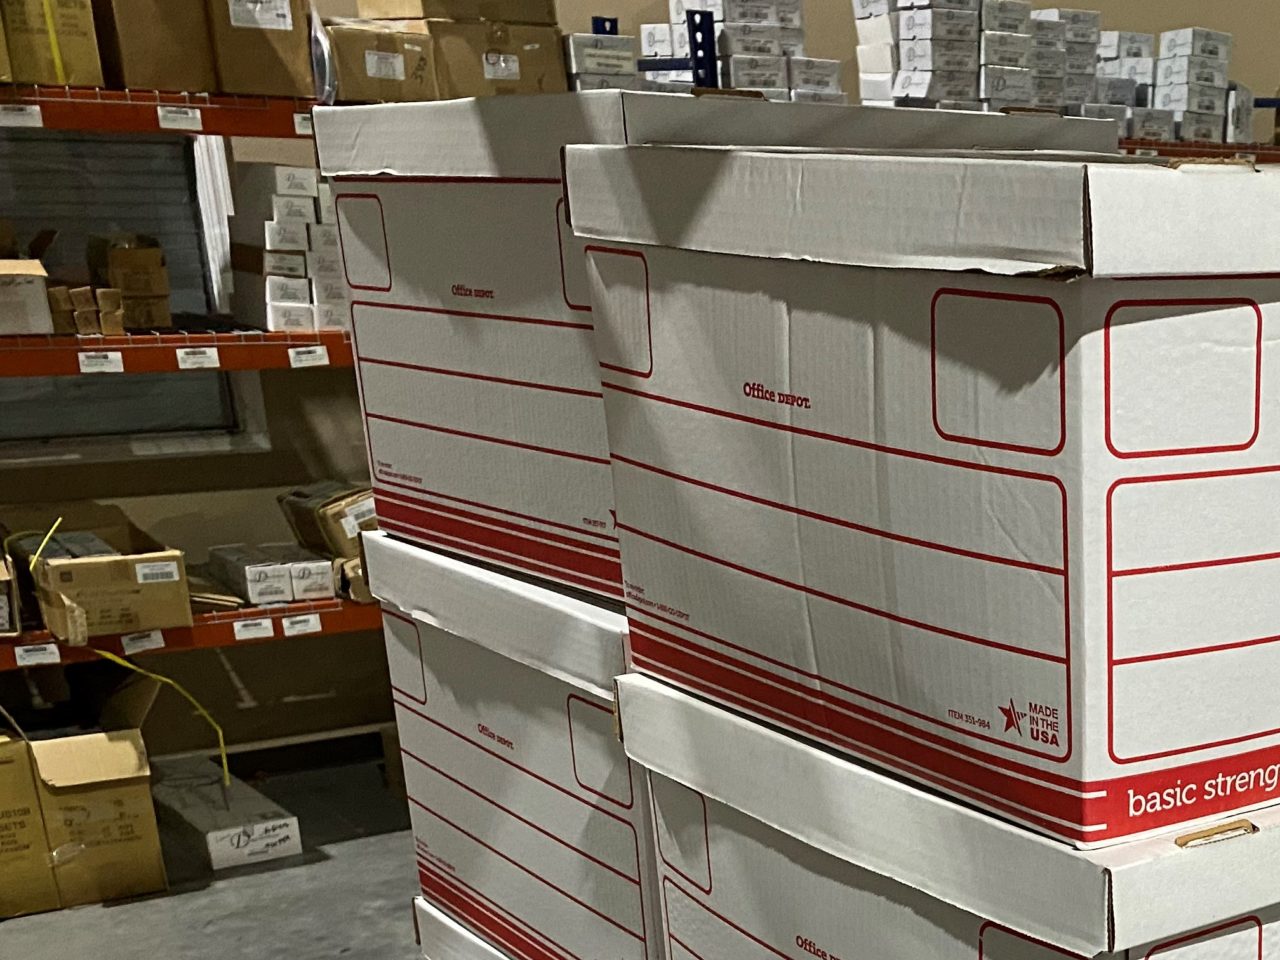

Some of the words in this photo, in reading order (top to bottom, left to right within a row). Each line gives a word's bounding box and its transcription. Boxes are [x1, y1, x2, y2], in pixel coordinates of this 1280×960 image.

[742, 381, 776, 402] Office
[947, 709, 964, 721] ITEM
[1028, 702, 1059, 720] MADE
[1029, 715, 1039, 727] IN
[1040, 718, 1060, 733] THE
[1030, 727, 1060, 747] USA
[1127, 779, 1198, 818] basic
[795, 935, 828, 960] Office
